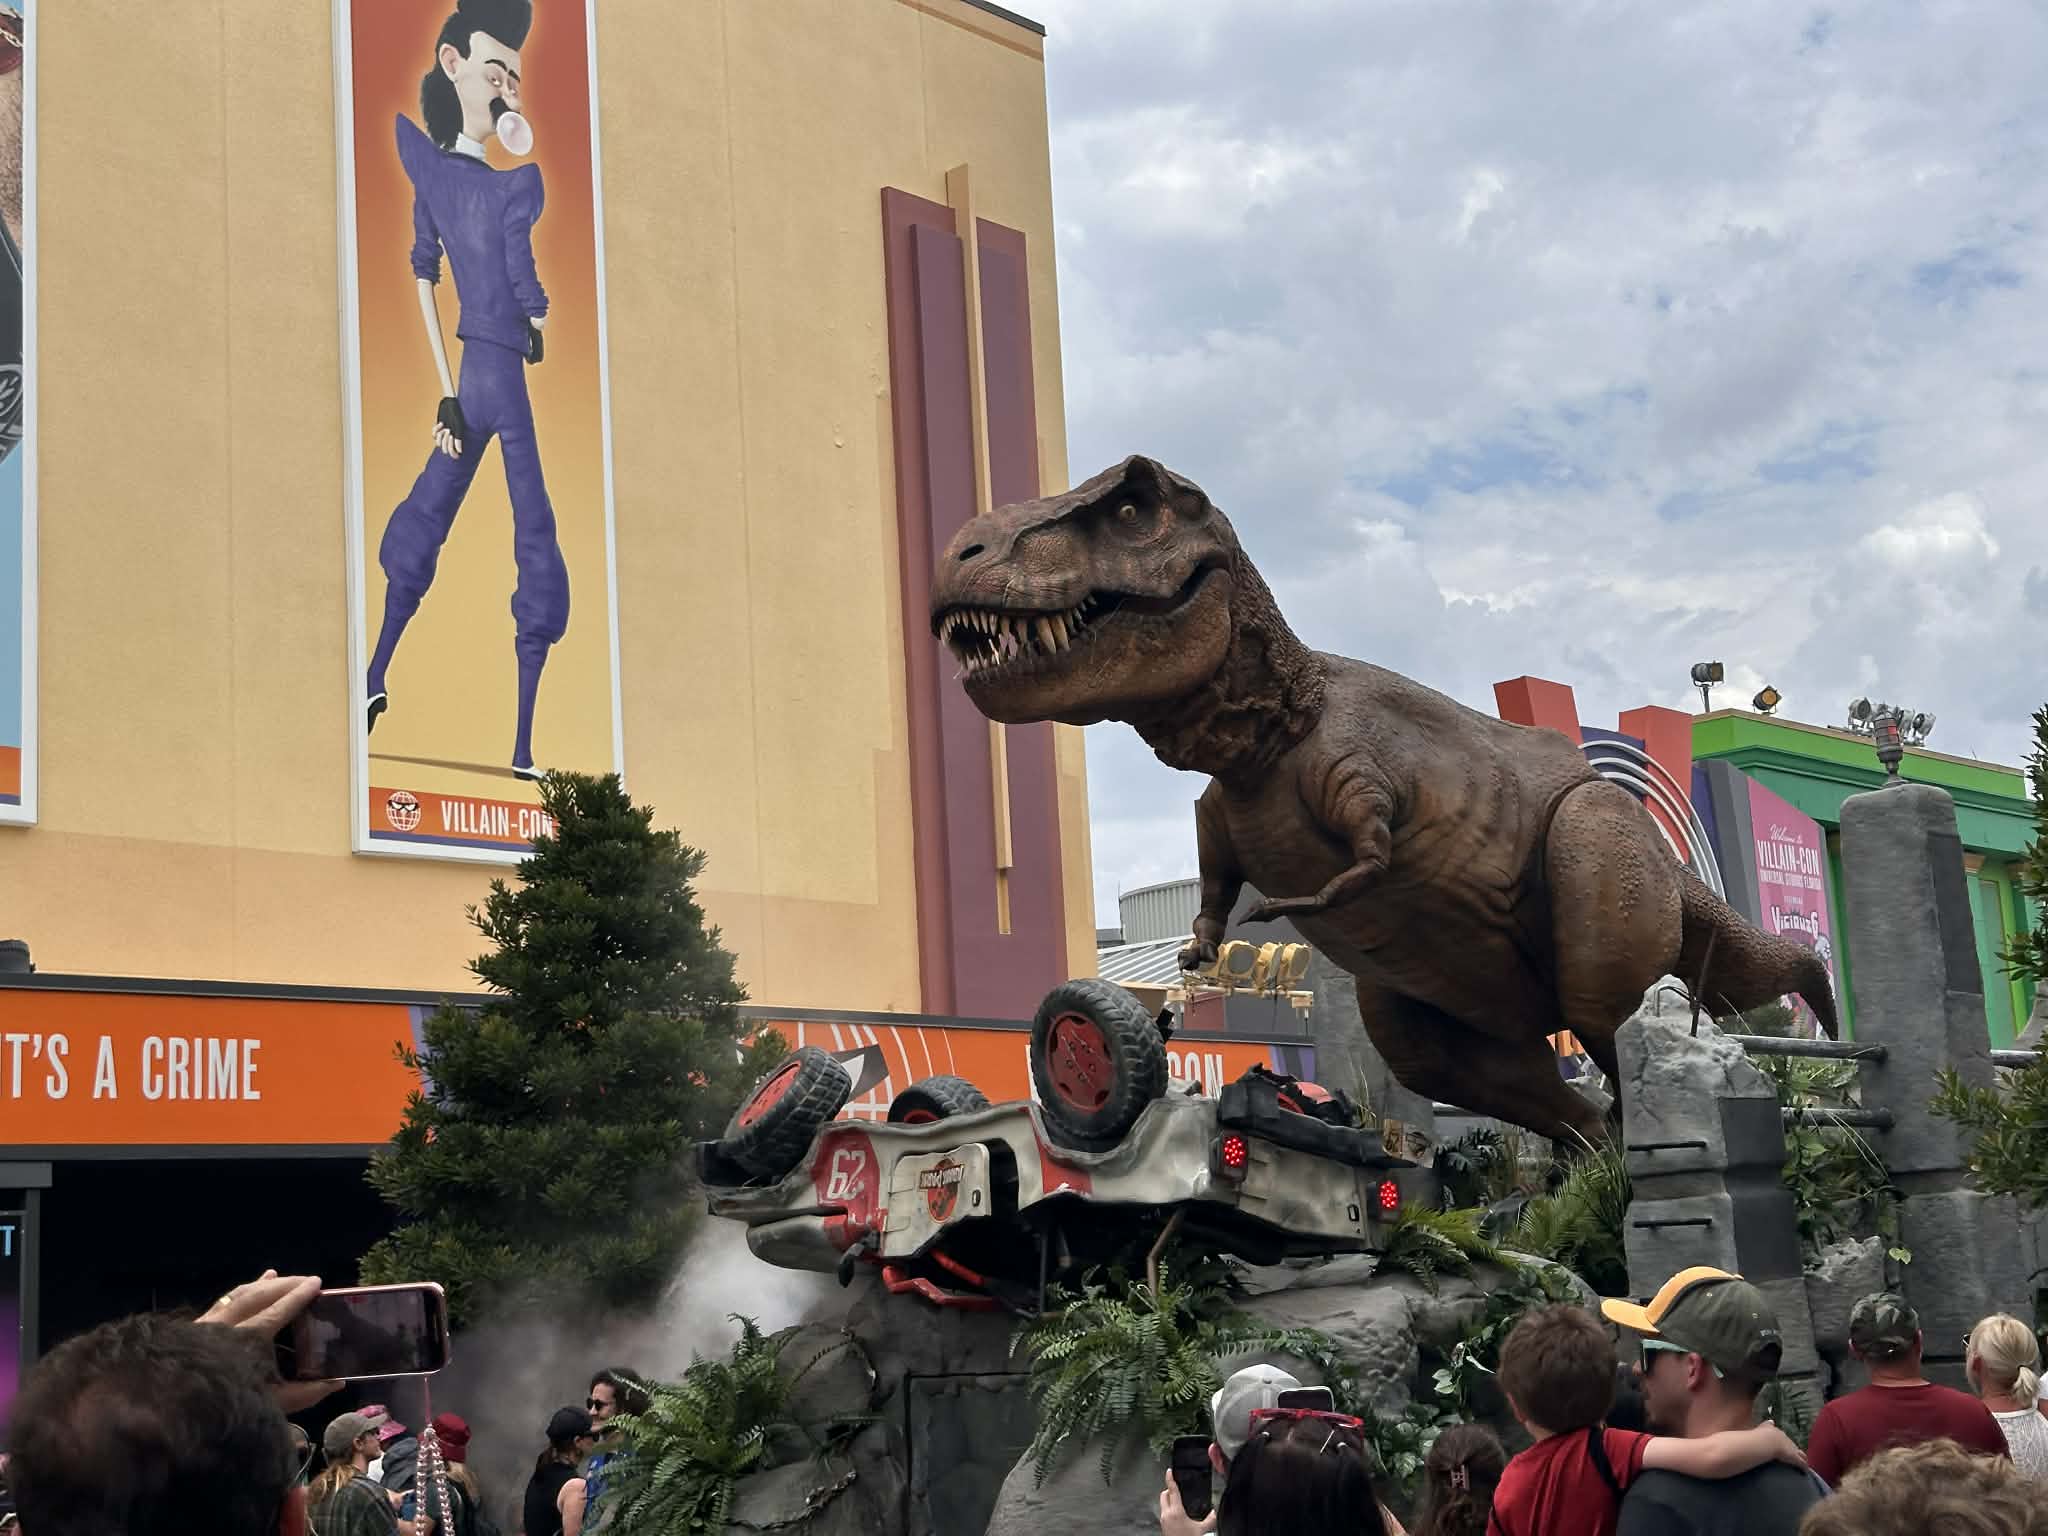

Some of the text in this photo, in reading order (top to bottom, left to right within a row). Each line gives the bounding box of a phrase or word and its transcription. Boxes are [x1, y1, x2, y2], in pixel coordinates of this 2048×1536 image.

[1757, 839, 1820, 877] VILLAIN-CON
[0, 1033, 261, 1100] T'S A CRIME
